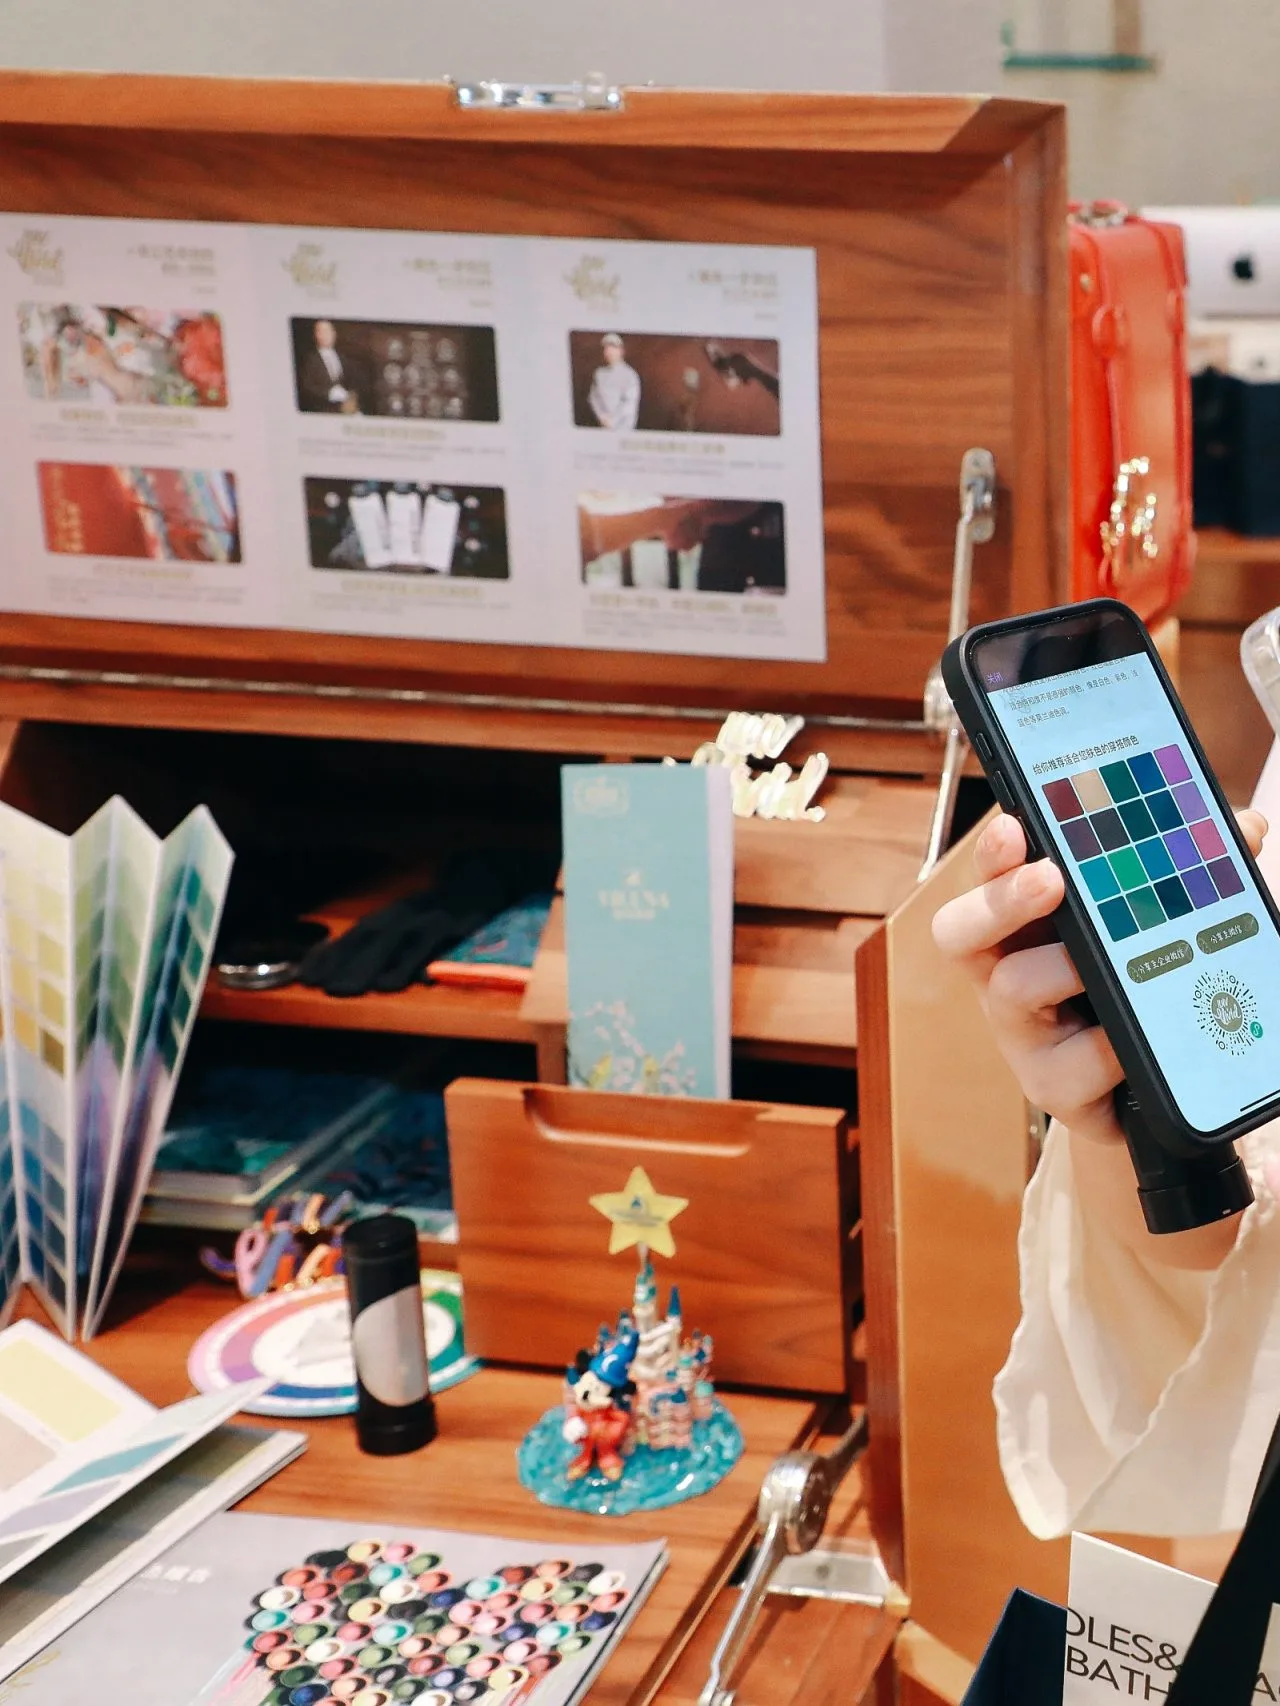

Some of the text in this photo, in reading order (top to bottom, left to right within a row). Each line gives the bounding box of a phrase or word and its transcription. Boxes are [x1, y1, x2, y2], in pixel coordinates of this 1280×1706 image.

[1210, 924, 1243, 944] 分享至微信
[1066, 1644, 1174, 1701] BATH
